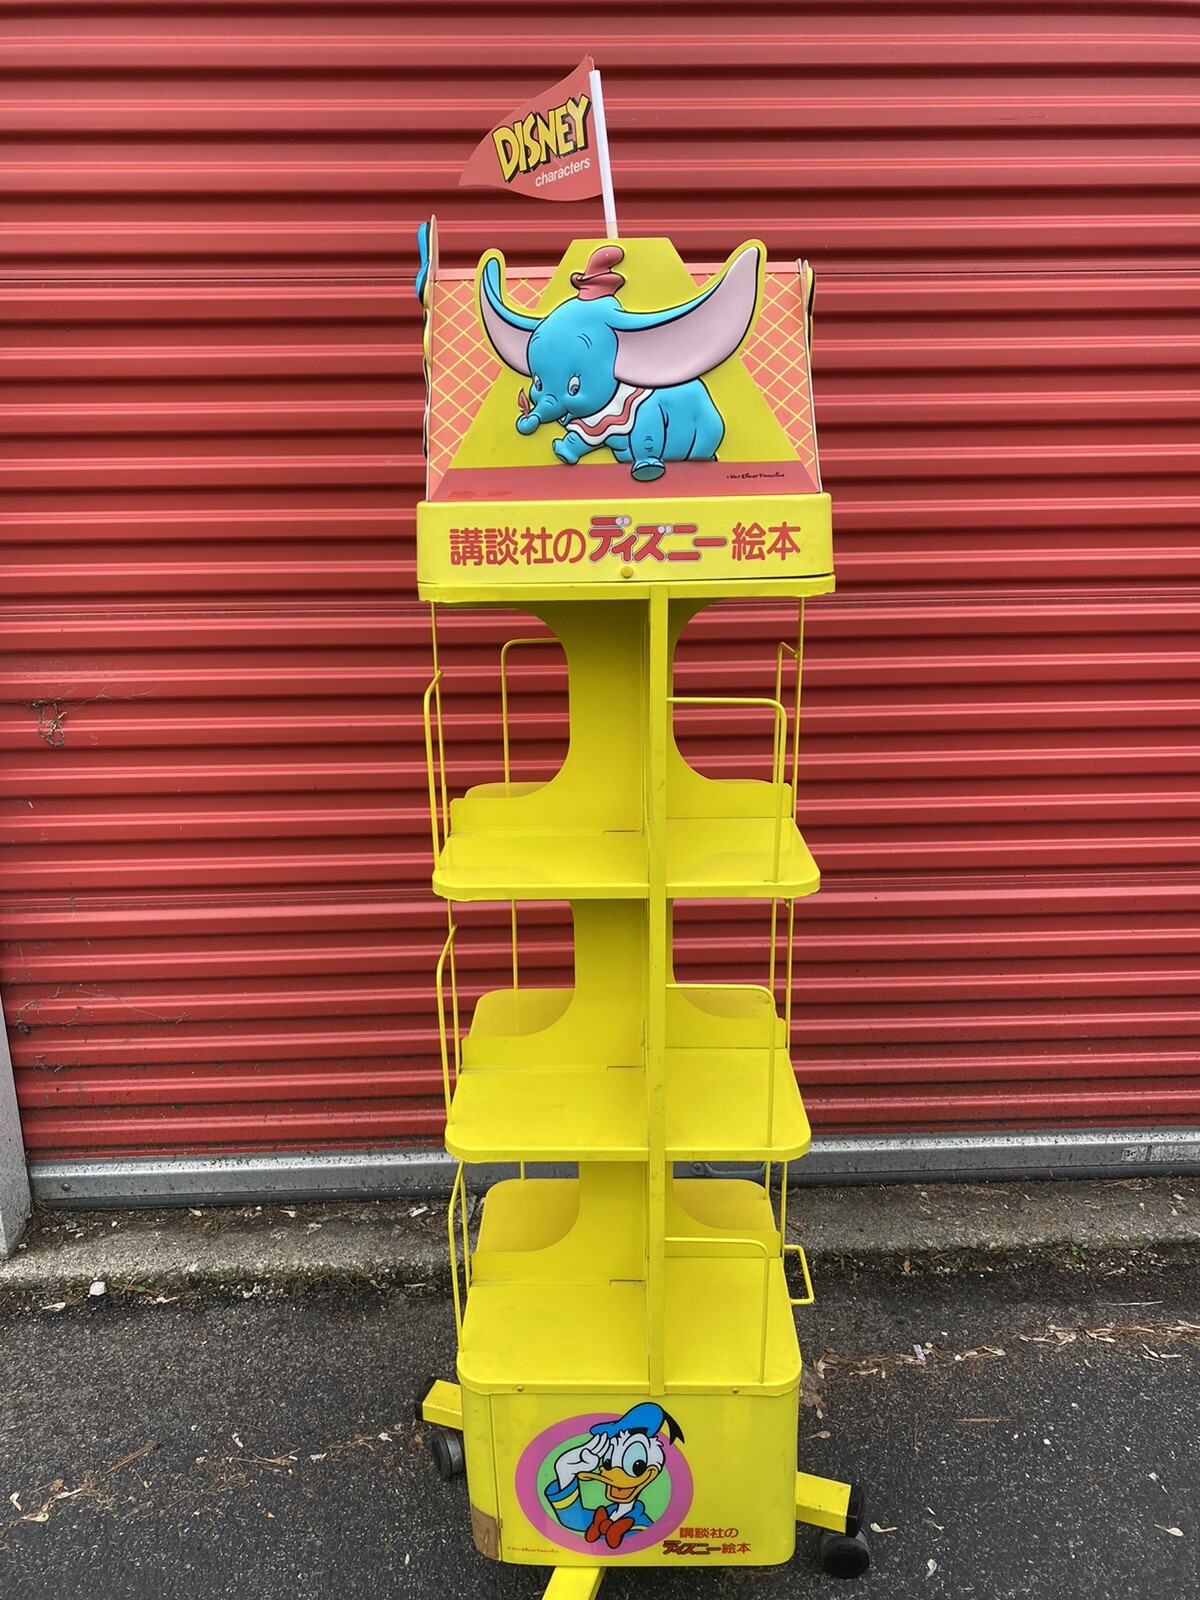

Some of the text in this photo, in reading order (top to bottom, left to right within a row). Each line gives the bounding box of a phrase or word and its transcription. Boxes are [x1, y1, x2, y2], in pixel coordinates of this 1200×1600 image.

[492, 94, 591, 183] DISNEY
[535, 157, 591, 187] characters
[449, 515, 802, 567] 講談社のディズニー絵本
[662, 1540, 752, 1555] ディズニー絵本
[679, 1527, 739, 1539] 講談社の
